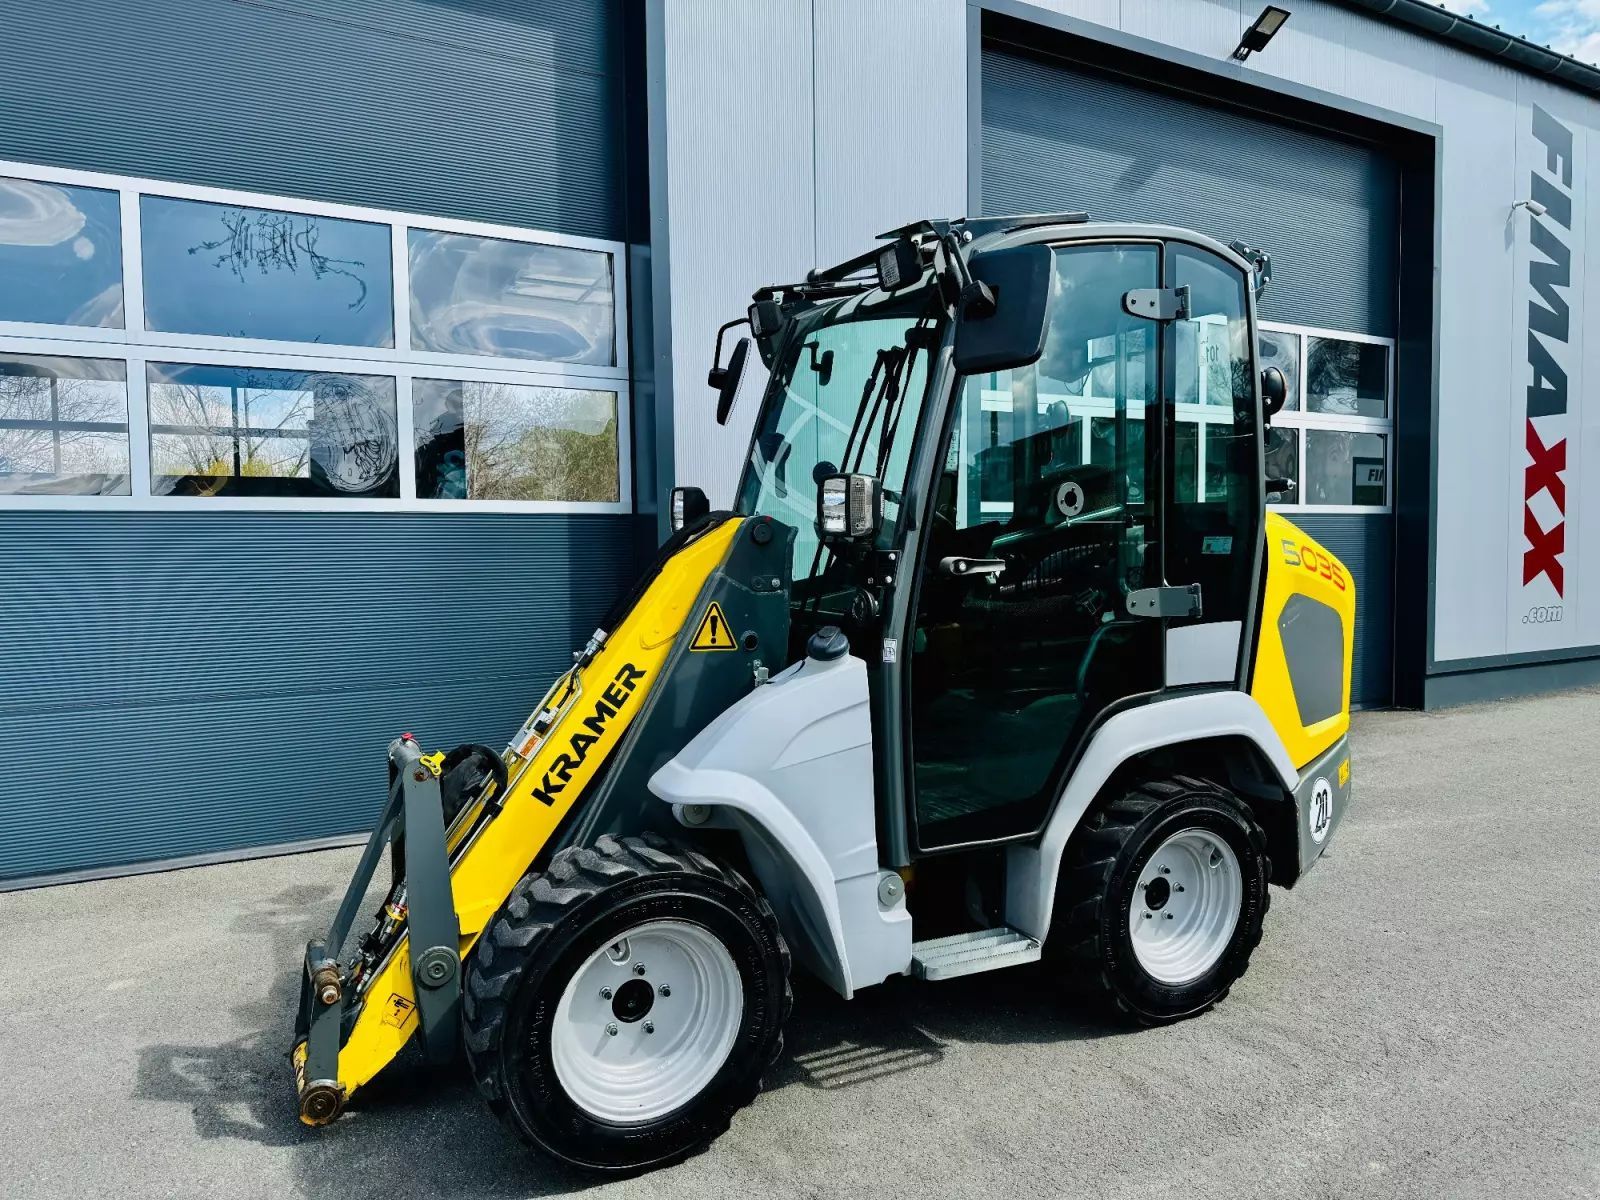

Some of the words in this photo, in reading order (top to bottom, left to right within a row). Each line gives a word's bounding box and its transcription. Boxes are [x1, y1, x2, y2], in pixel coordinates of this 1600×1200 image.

[1522, 102, 1574, 600] FIMAXX
[1281, 539, 1346, 592] 5035
[530, 662, 648, 807] KRAMER
[1313, 788, 1328, 834] 20
